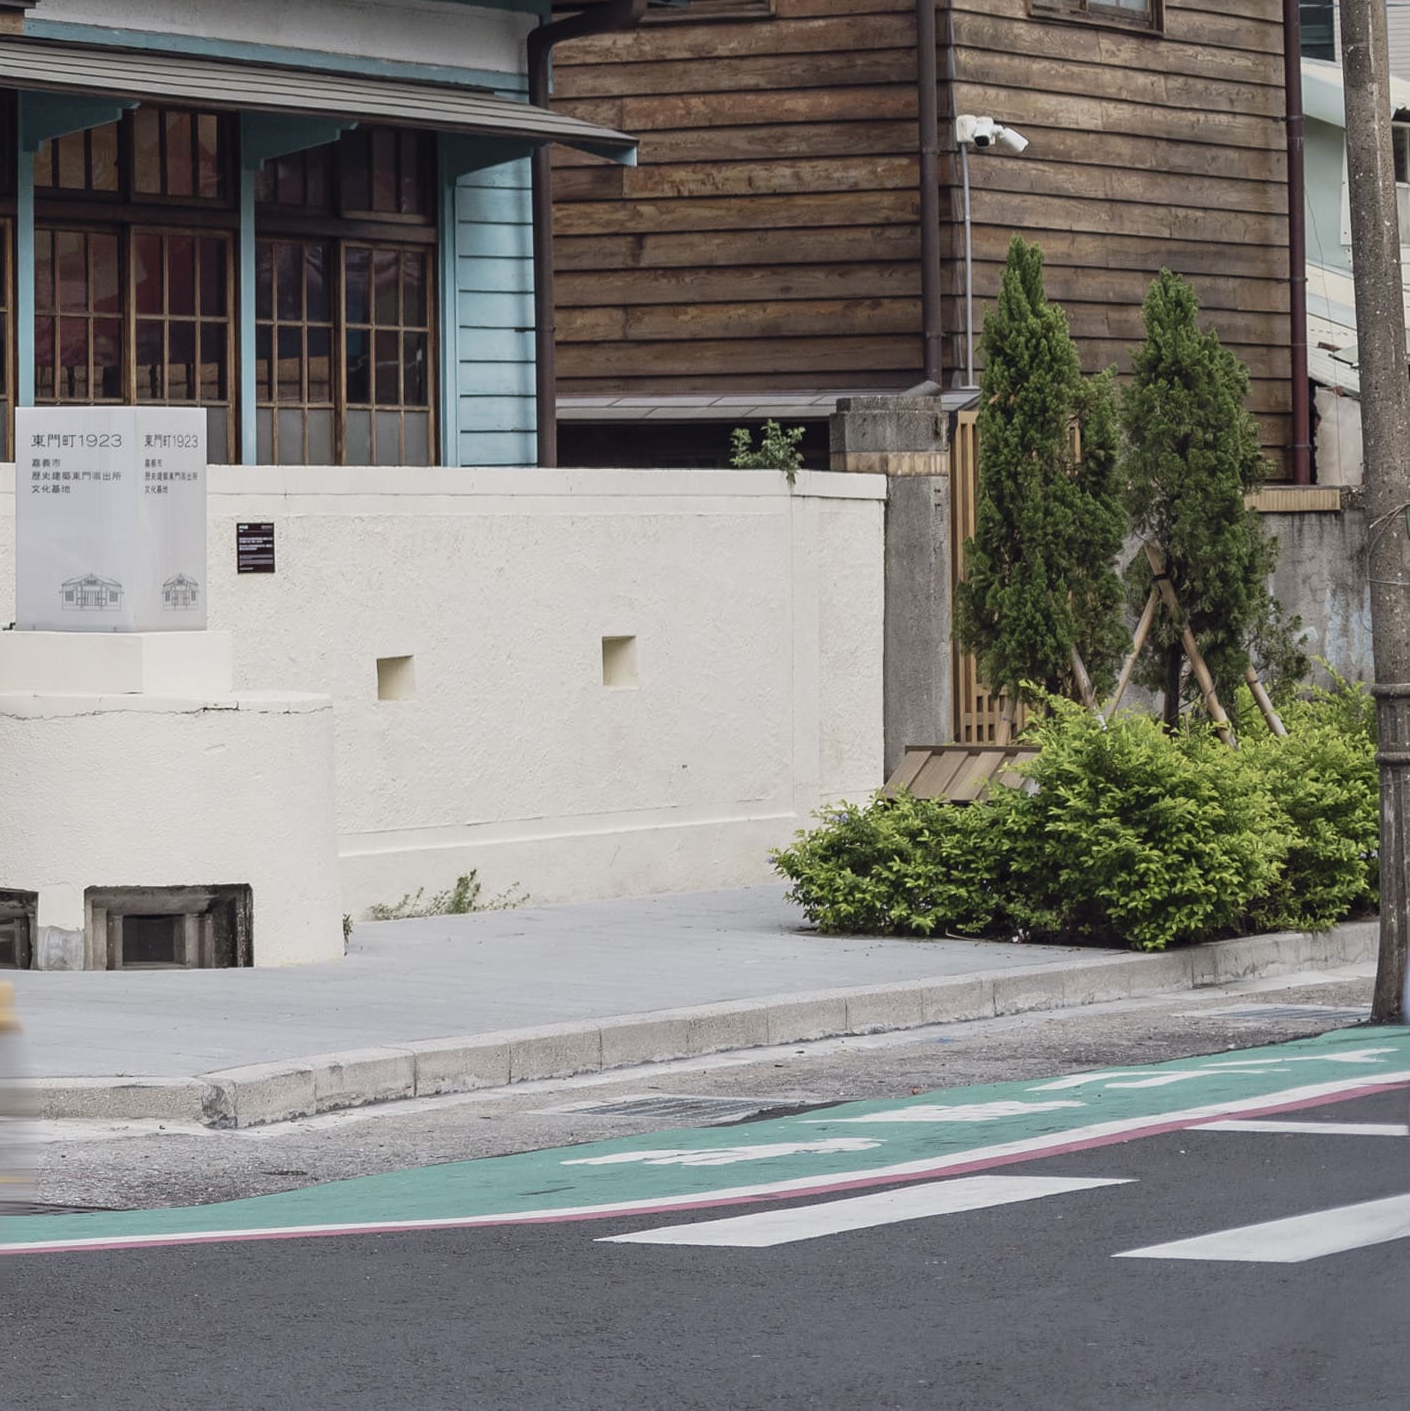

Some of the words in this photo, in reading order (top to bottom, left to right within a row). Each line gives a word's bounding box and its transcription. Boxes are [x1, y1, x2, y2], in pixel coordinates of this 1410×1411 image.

[30, 433, 123, 448] 東門町1923
[144, 434, 199, 449] 東門町1923
[31, 458, 61, 468] 嘉義市
[31, 485, 71, 494] 文化基地
